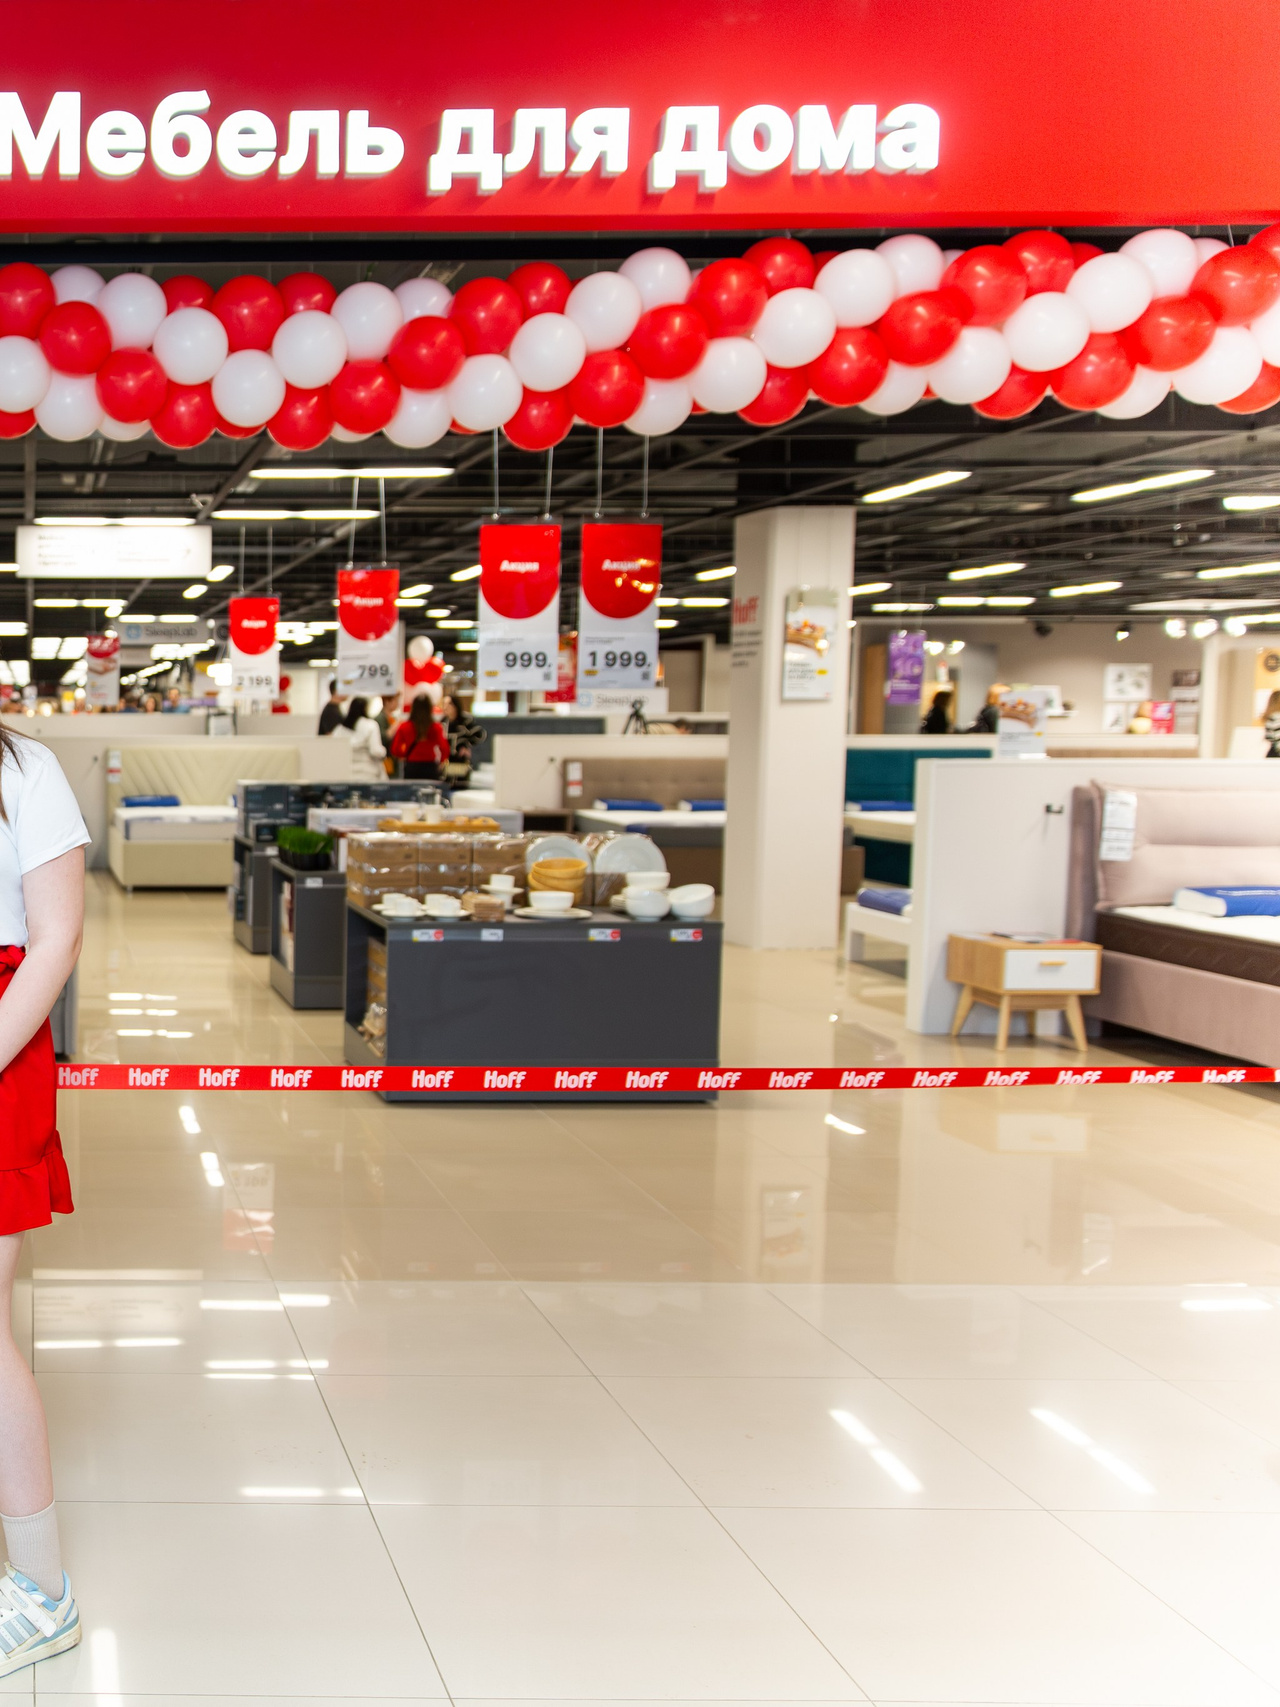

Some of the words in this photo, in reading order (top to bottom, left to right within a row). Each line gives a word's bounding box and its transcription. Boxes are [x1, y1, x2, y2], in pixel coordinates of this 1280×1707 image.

[428, 106, 631, 197] для
[650, 102, 942, 195] дома
[500, 560, 540, 573] Акция
[58, 1067, 99, 1086] Hoff
[128, 1068, 169, 1086] Hoff
[199, 1068, 240, 1087] Hoff
[270, 1069, 312, 1087] Hoff
[341, 1070, 383, 1088] Hoff
[412, 1070, 454, 1088] Hoff
[483, 1071, 526, 1089] Hoff
[554, 1071, 597, 1089] Hoff
[626, 1071, 669, 1089] Hoff
[697, 1071, 741, 1089] Hoff
[769, 1071, 813, 1088] Hoff
[839, 1071, 885, 1088] Hoff
[912, 1071, 958, 1087] Hoff
[984, 1071, 1030, 1086] Hoff
